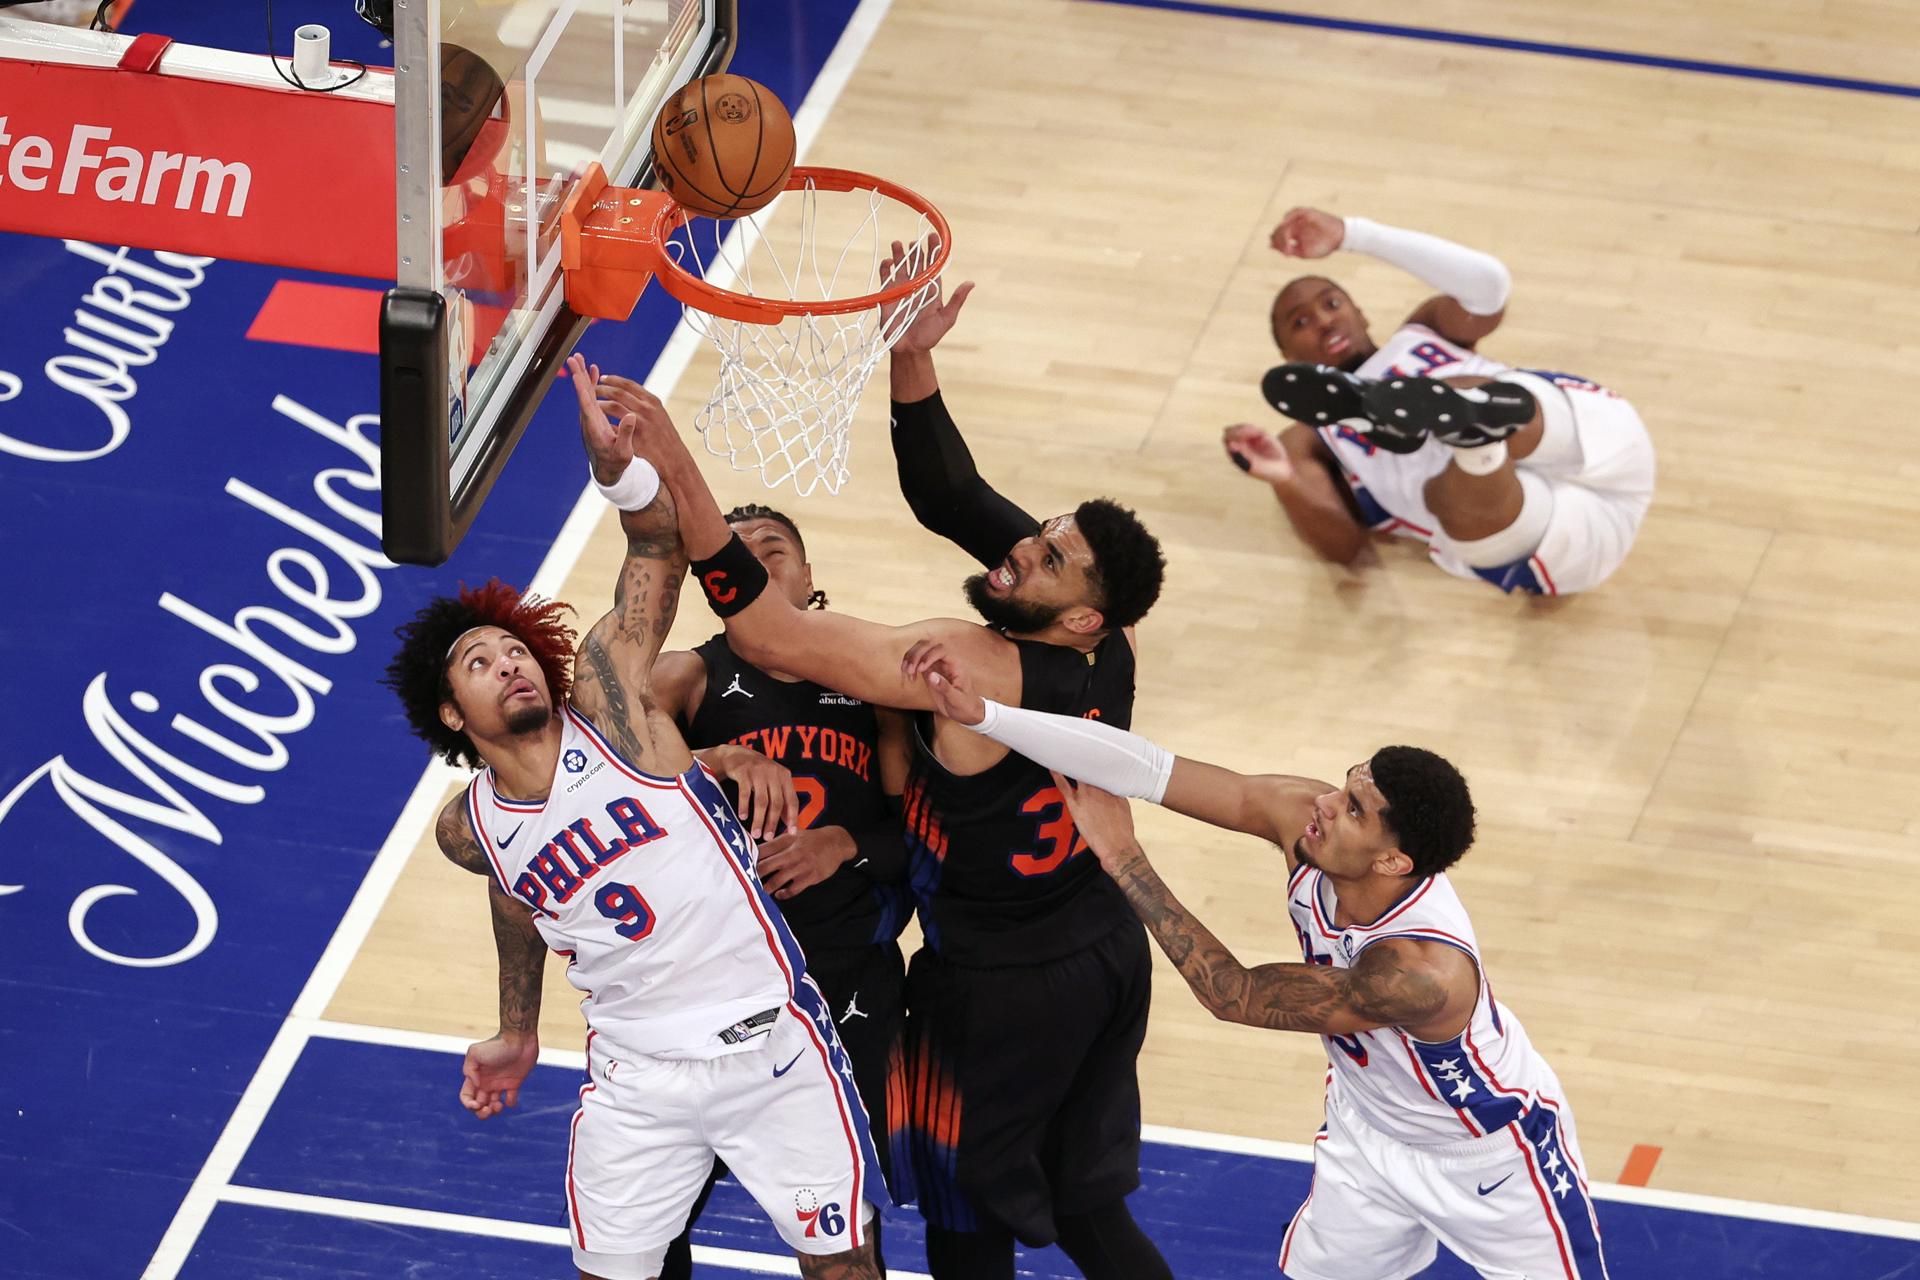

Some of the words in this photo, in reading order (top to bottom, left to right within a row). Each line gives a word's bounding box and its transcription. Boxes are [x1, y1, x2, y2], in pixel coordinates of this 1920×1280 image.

[566, 760, 606, 794] crypto.com
[795, 725, 872, 783] YORK
[512, 796, 669, 921] PHILA
[1010, 785, 1089, 877] 3
[594, 881, 657, 943] 9
[795, 1202, 846, 1239] 76
